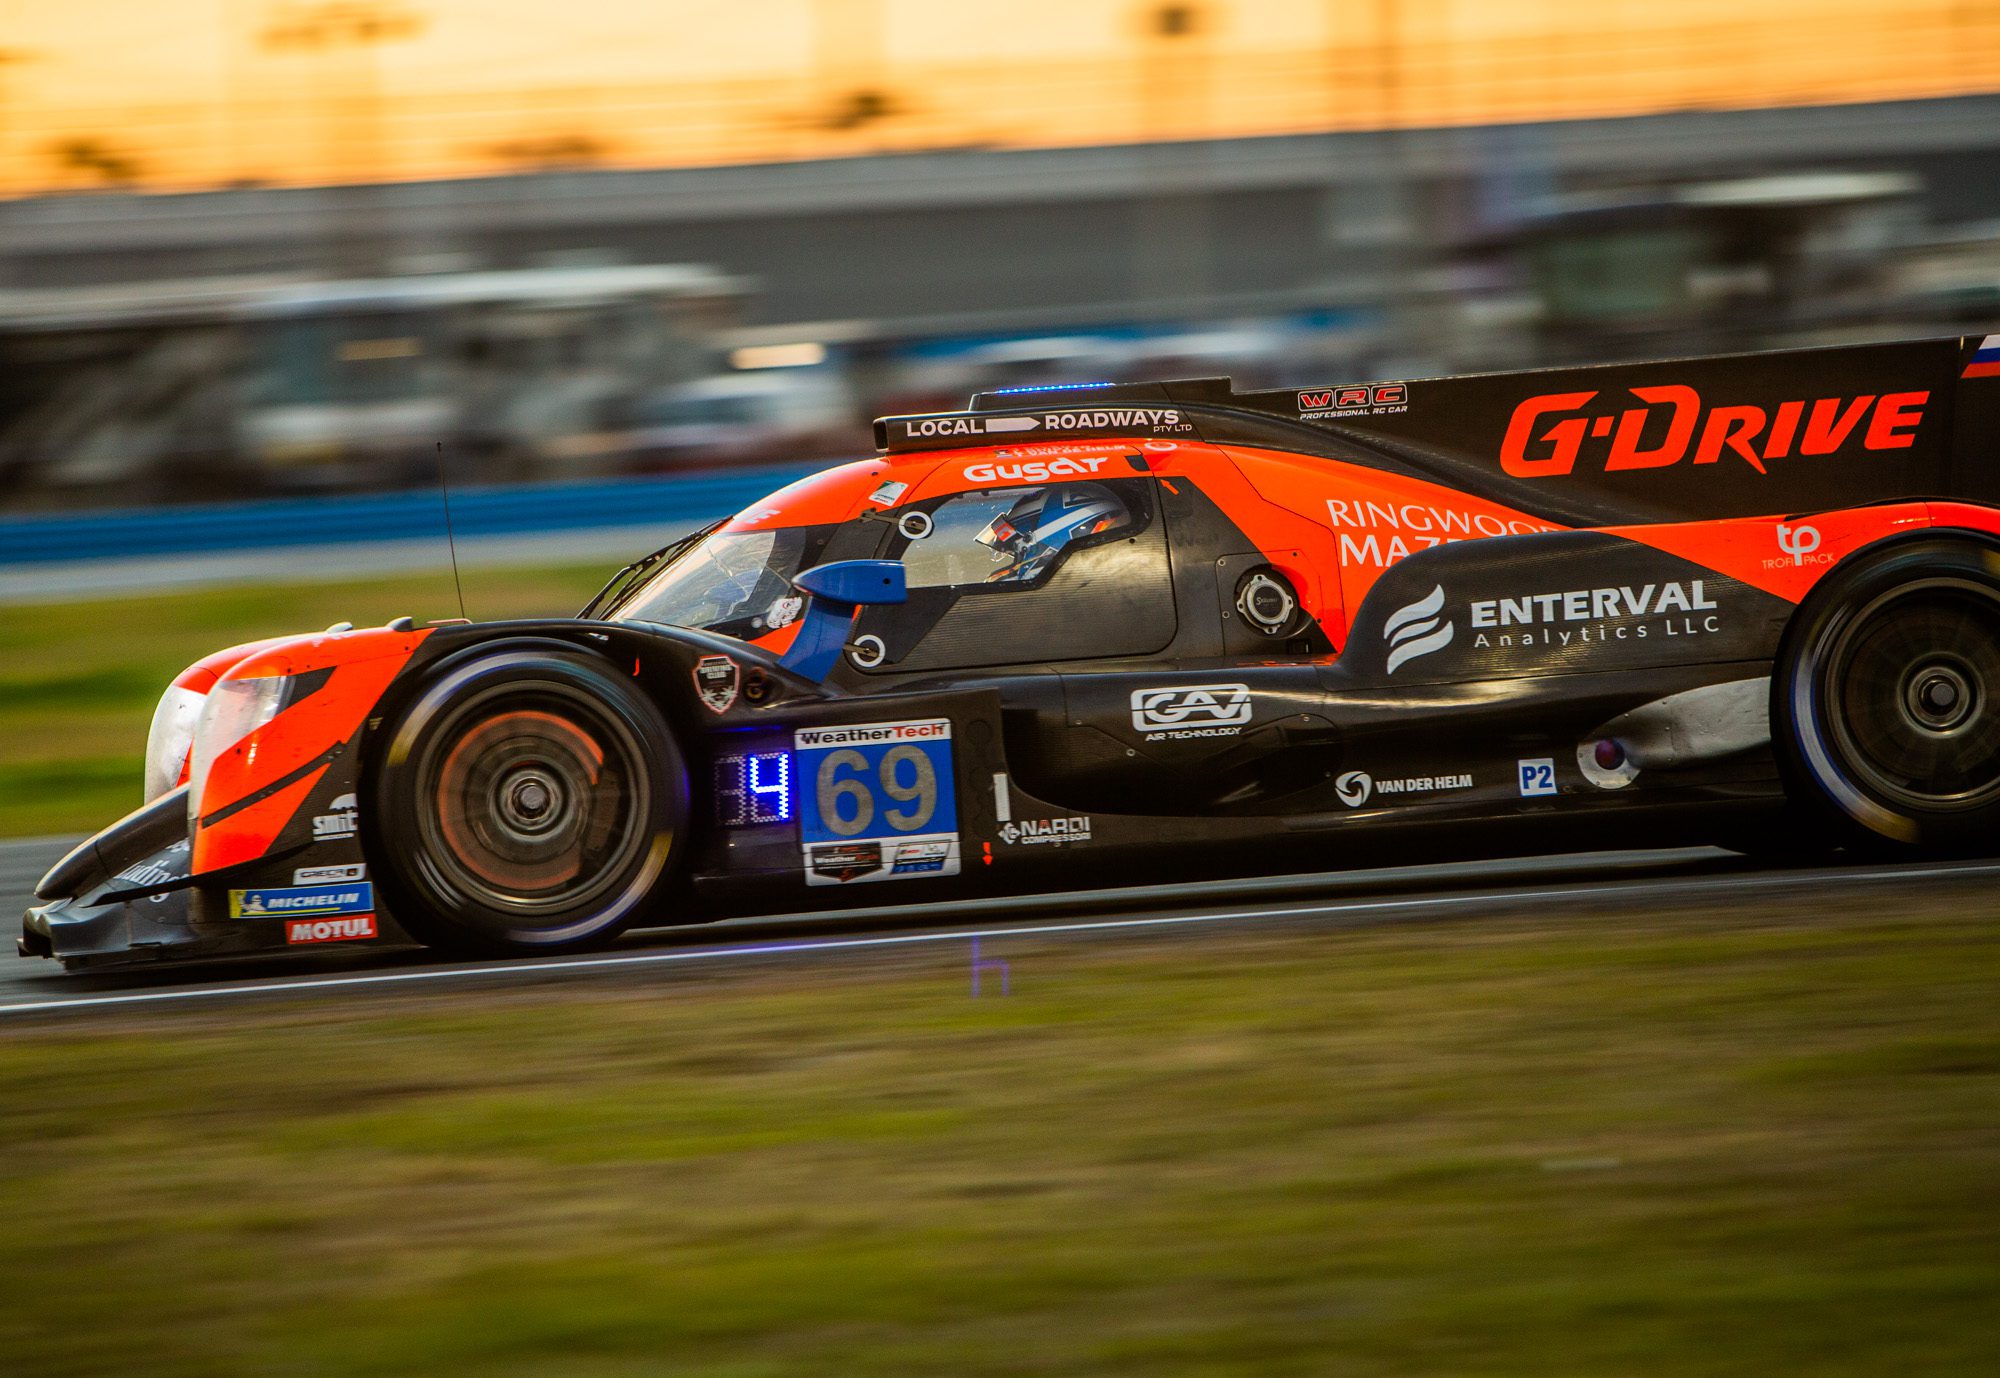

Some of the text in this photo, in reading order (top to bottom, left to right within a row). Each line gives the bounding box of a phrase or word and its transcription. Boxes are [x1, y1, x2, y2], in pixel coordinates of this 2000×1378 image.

[1300, 387, 1403, 408] WRC
[906, 410, 1180, 437] LOCAL ROADWAYS
[1300, 405, 1408, 420] PROFESSIONAL RC CAR
[1153, 424, 1193, 433] PTY LTD
[1470, 580, 1718, 628] ENTERVAL
[1474, 616, 1720, 648] Analytics LLC
[801, 723, 945, 745] WeatherTech
[1145, 727, 1242, 741] AIR TECHNOLOGY
[749, 753, 789, 819] 4
[1376, 774, 1473, 794] VAN DER HELM
[1521, 765, 1554, 789] P2
[816, 745, 937, 836] 69
[1020, 816, 1091, 836] NARDI
[267, 893, 360, 909] MICHELIN
[291, 918, 373, 941] MOTUL
